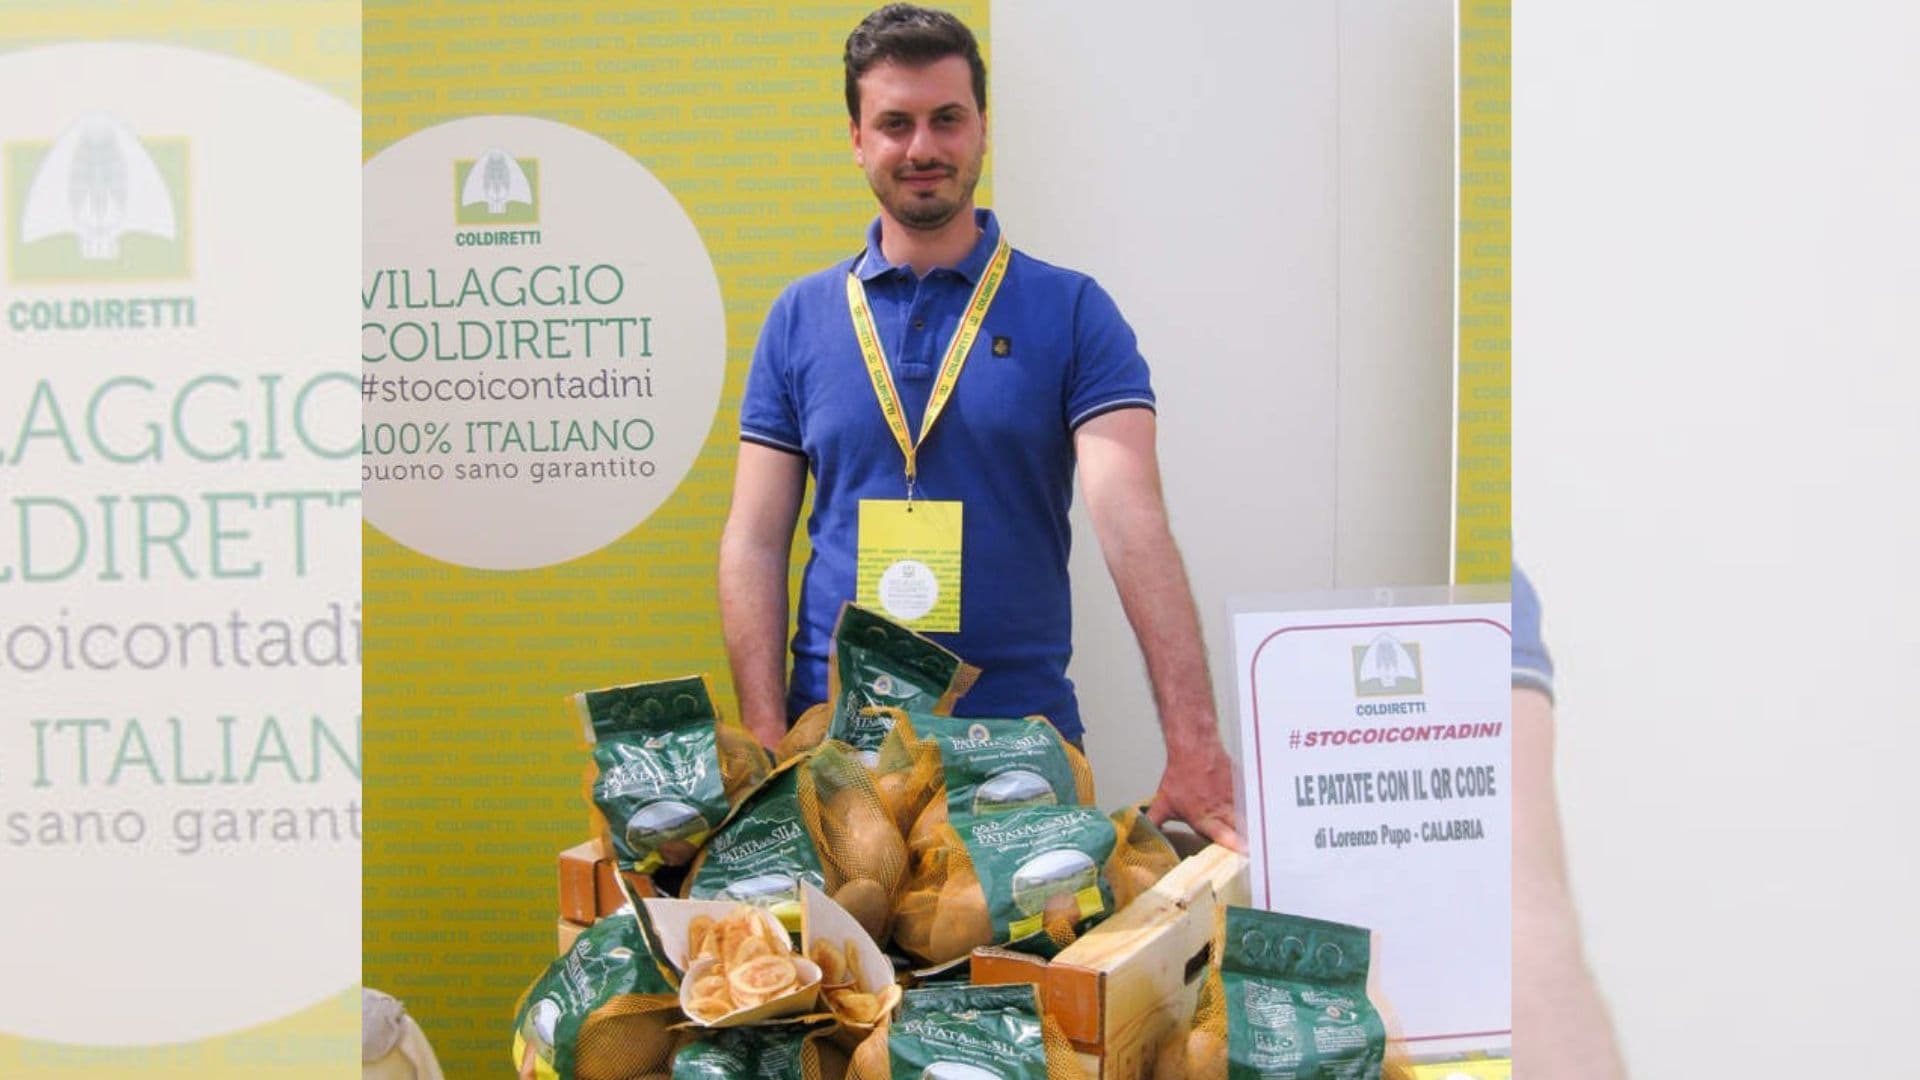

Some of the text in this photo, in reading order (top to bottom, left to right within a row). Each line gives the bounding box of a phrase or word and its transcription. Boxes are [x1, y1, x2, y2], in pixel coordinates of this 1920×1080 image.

[456, 231, 541, 246] COLDIRETTI
[362, 264, 624, 309] VILLAGGIO
[8, 296, 195, 331] COLDIRETTI
[362, 317, 653, 362] COLDIRETTI
[362, 368, 654, 402] #stocoicontadini
[0, 371, 362, 465] AGGIO
[465, 418, 655, 454] ITALIANO
[455, 462, 518, 480] sano
[530, 457, 656, 484] garantito
[0, 490, 362, 583] DIRET
[0, 602, 362, 671] oicontadi
[1356, 702, 1426, 717] COLDIRETTI
[1289, 721, 1502, 749] #STOCOICONTADINI
[1295, 765, 1497, 807] LE PATATE CON IL QR CODE
[7, 808, 146, 847] sano
[1315, 827, 1327, 848] di
[1329, 826, 1378, 848] Lorenzo
[1381, 824, 1412, 849] Pupo
[1421, 818, 1485, 842] CALABRIA
